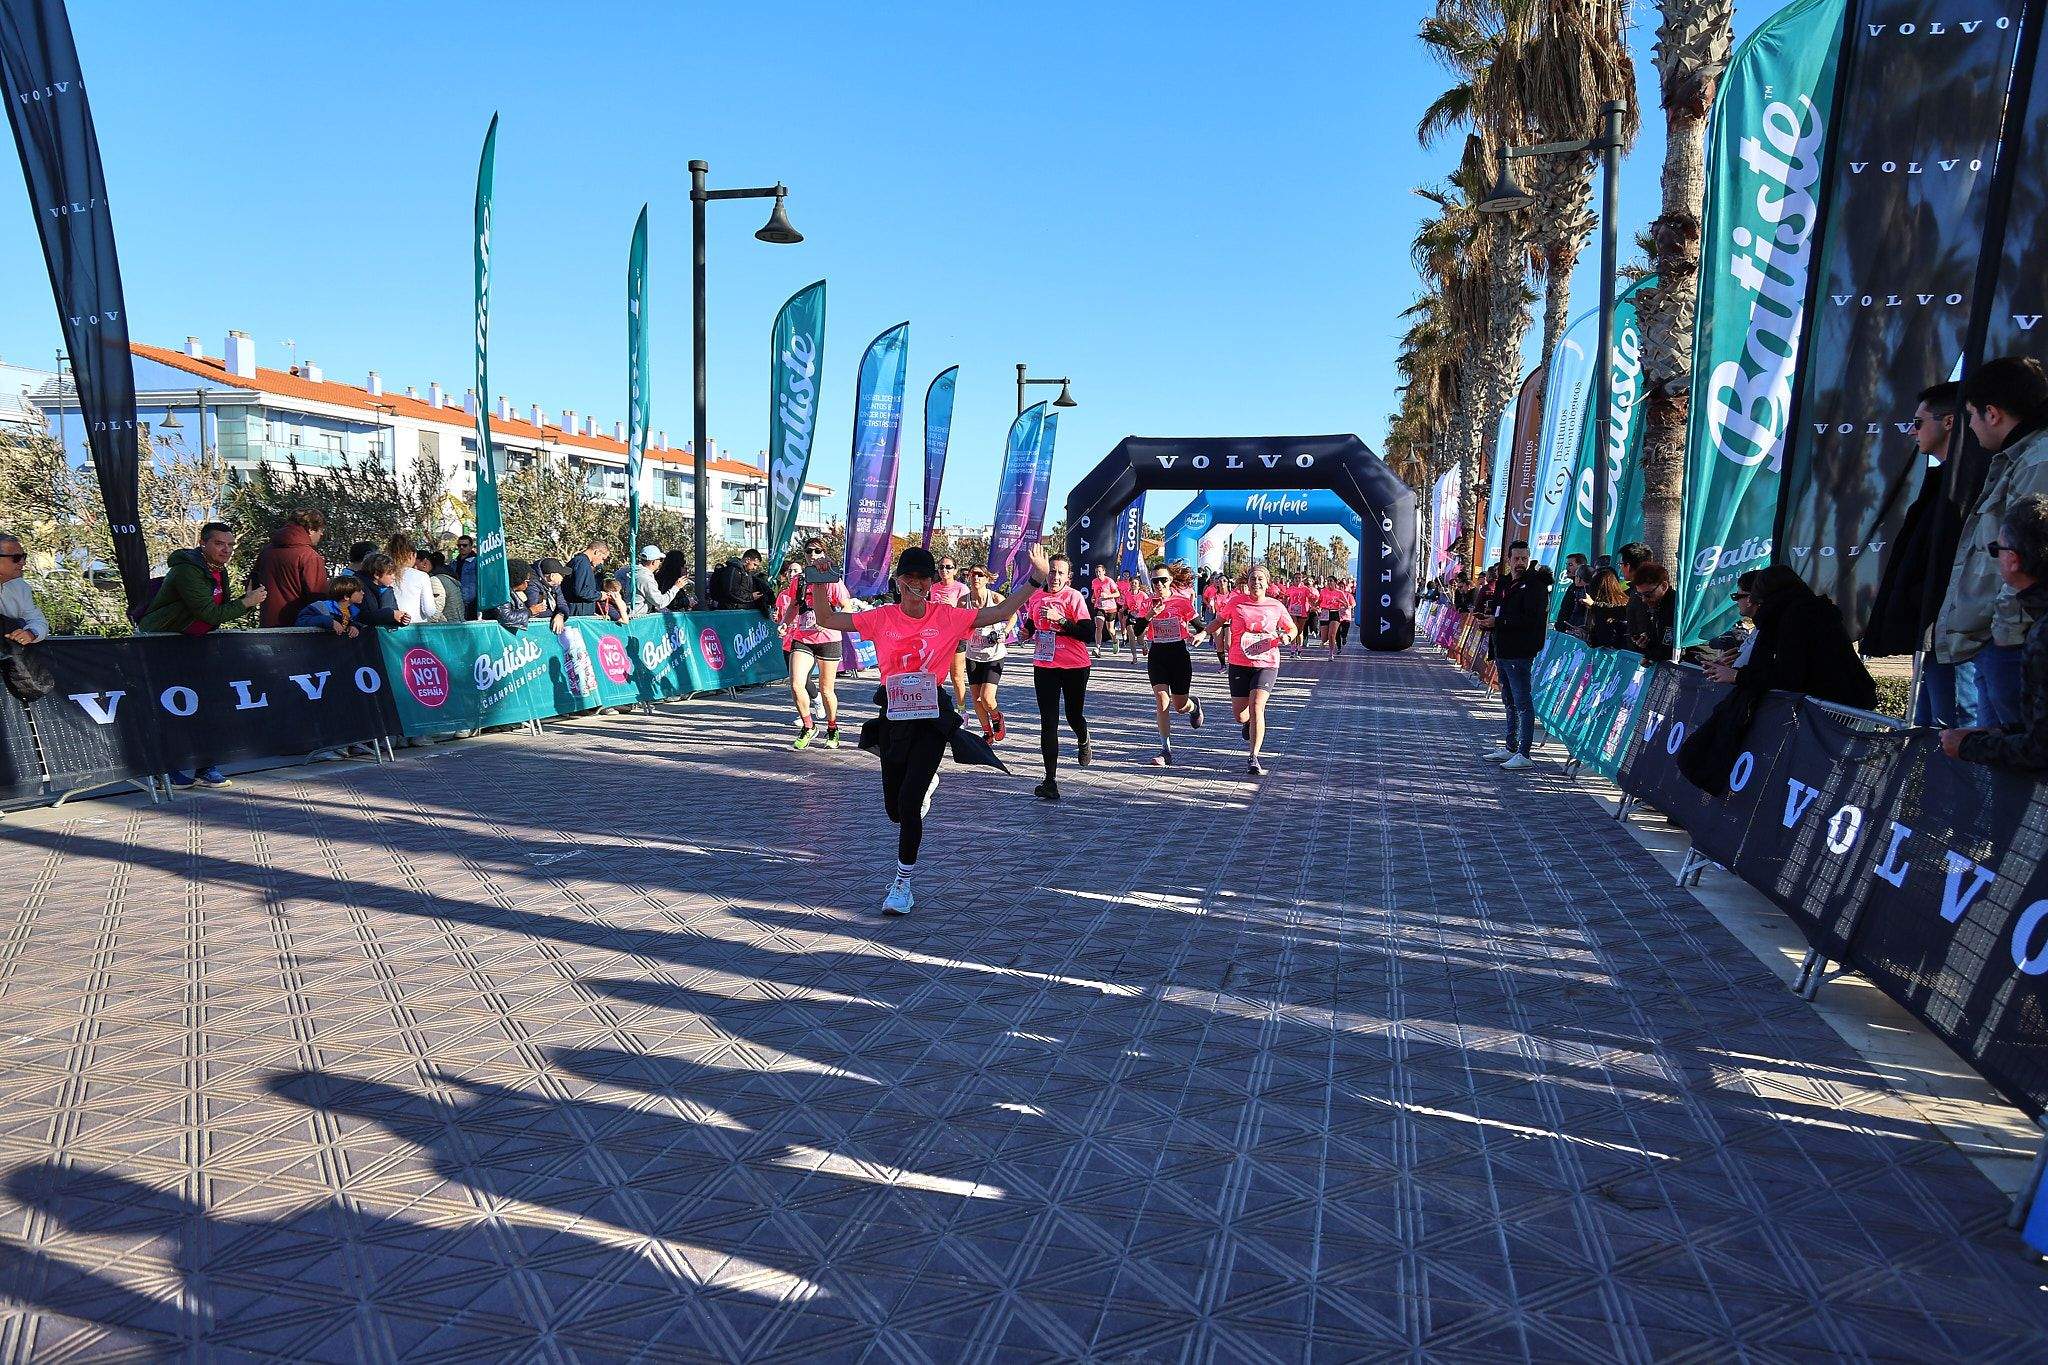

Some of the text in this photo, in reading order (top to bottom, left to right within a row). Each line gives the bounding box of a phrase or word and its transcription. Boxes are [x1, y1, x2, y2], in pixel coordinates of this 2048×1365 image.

[1867, 16, 2010, 37] VOLVO
[1849, 158, 1983, 175] VOLVO
[1707, 93, 1824, 473] Batiste
[1831, 292, 1963, 307] VOLVO
[771, 330, 817, 513] Batiste
[1813, 422, 1914, 435] VOLV
[1155, 452, 1315, 469] VOLVO
[1520, 440, 1534, 488] Institutos
[1245, 492, 1309, 520] Marlene
[1080, 515, 1091, 600] OLVO
[1694, 536, 1773, 576] Batis
[1792, 541, 1887, 557] VOLV
[1380, 517, 1393, 635] VOLVO
[643, 624, 688, 671] Batiste
[733, 621, 770, 660] Batiste
[473, 637, 543, 691] Batiste
[67, 666, 382, 725] VOLVO
[902, 692, 922, 702] 016
[1643, 709, 1754, 792] VOO
